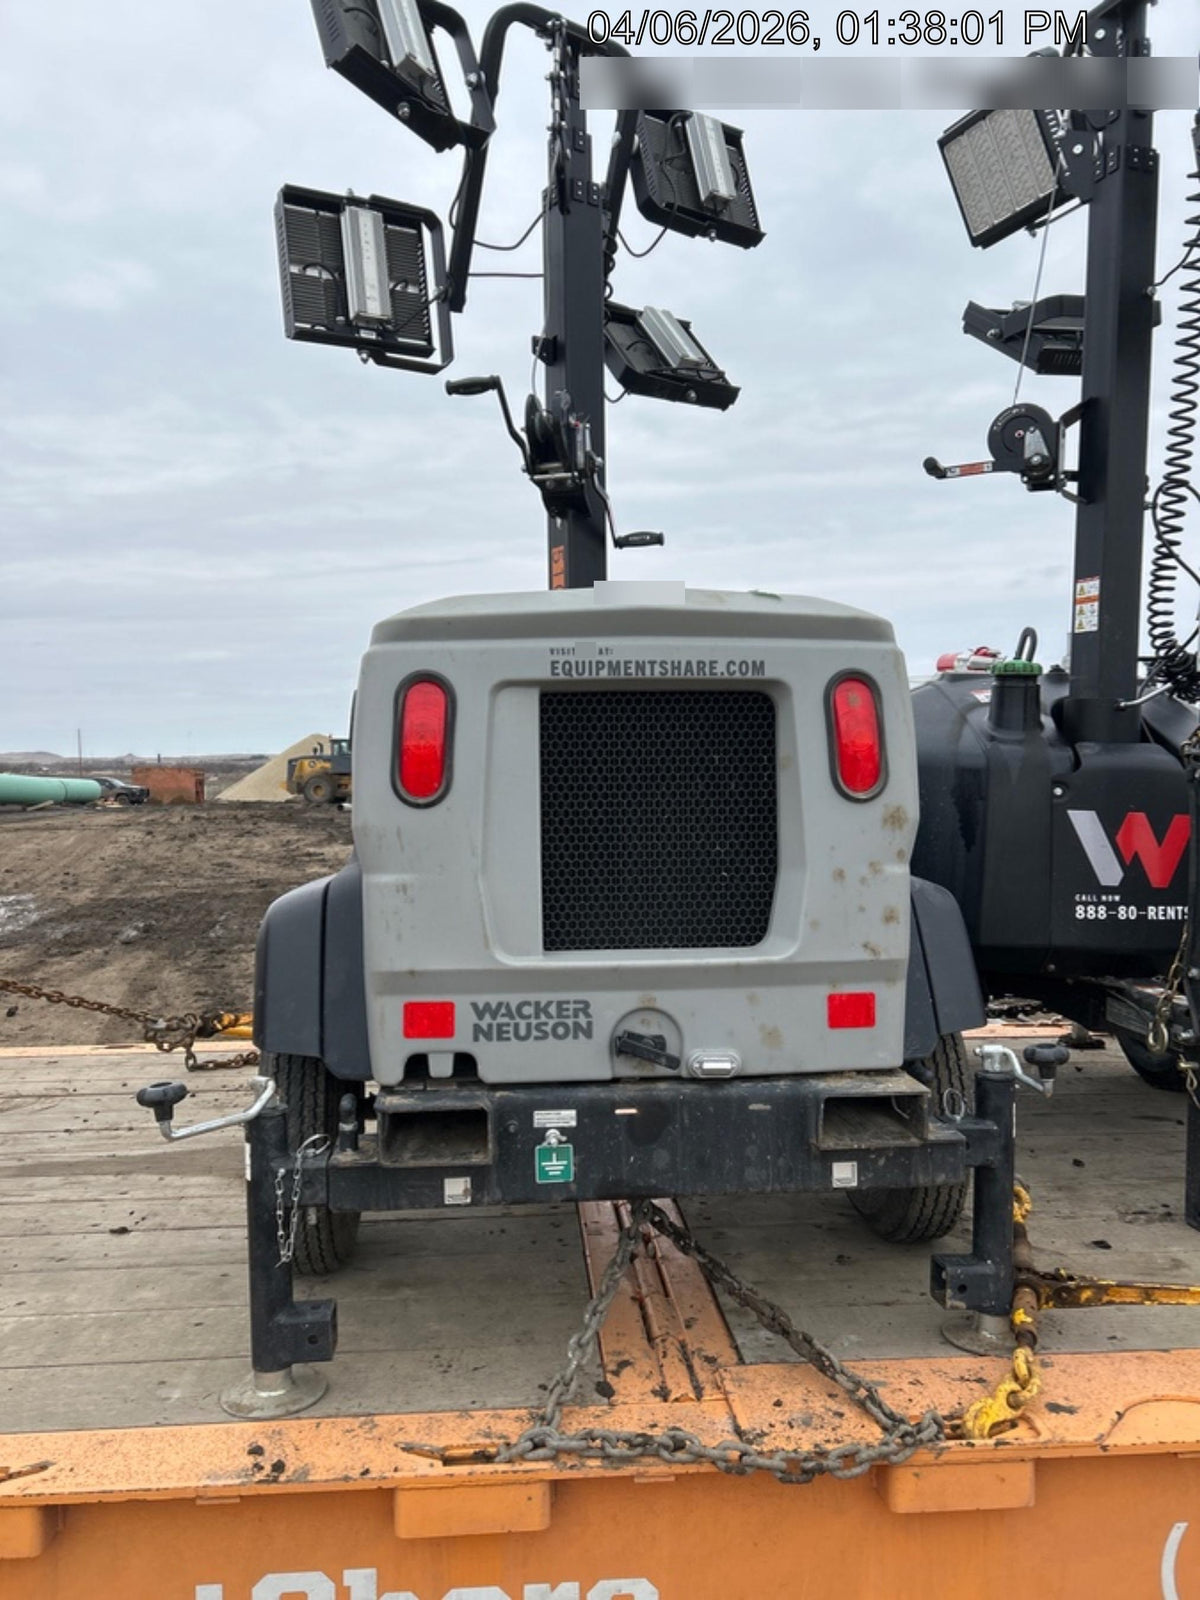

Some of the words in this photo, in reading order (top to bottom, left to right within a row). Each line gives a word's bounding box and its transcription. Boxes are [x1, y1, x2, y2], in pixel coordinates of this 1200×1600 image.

[550, 659, 766, 678] EQUIPMENTSHARE.COM
[1074, 894, 1098, 902] CALL
[470, 1000, 593, 1021] WACKER
[472, 1020, 593, 1042] NEUSON
